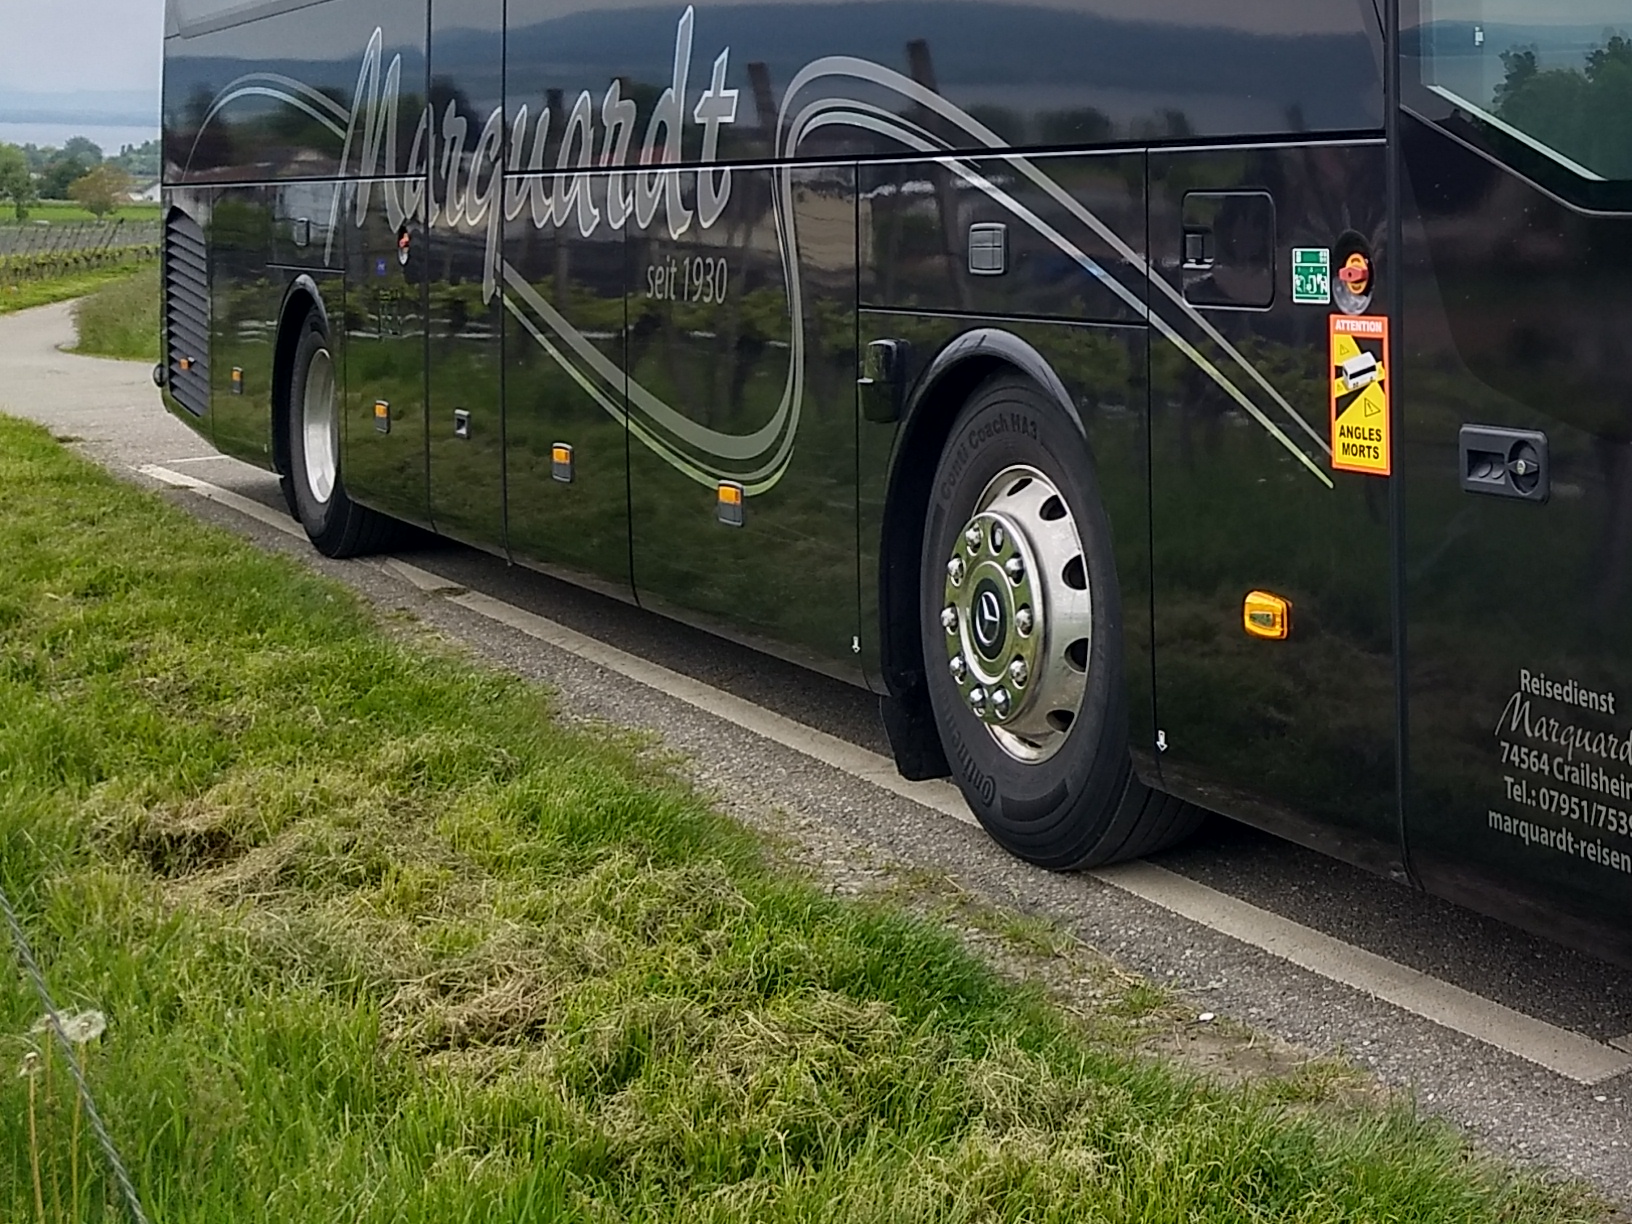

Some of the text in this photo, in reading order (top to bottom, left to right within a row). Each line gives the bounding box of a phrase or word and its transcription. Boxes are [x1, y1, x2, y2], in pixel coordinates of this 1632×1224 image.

[323, 4, 739, 306] Marquardt
[646, 255, 729, 305] seit 1930
[1335, 319, 1383, 333] ATTENTION
[1339, 424, 1382, 443] ANGLES
[1341, 442, 1380, 460] MORTS
[940, 412, 1038, 500] Conti Coach HA3
[1520, 669, 1616, 715] Reisedienst
[1500, 741, 1550, 776] 74564
[1503, 776, 1537, 807] Tel.:
